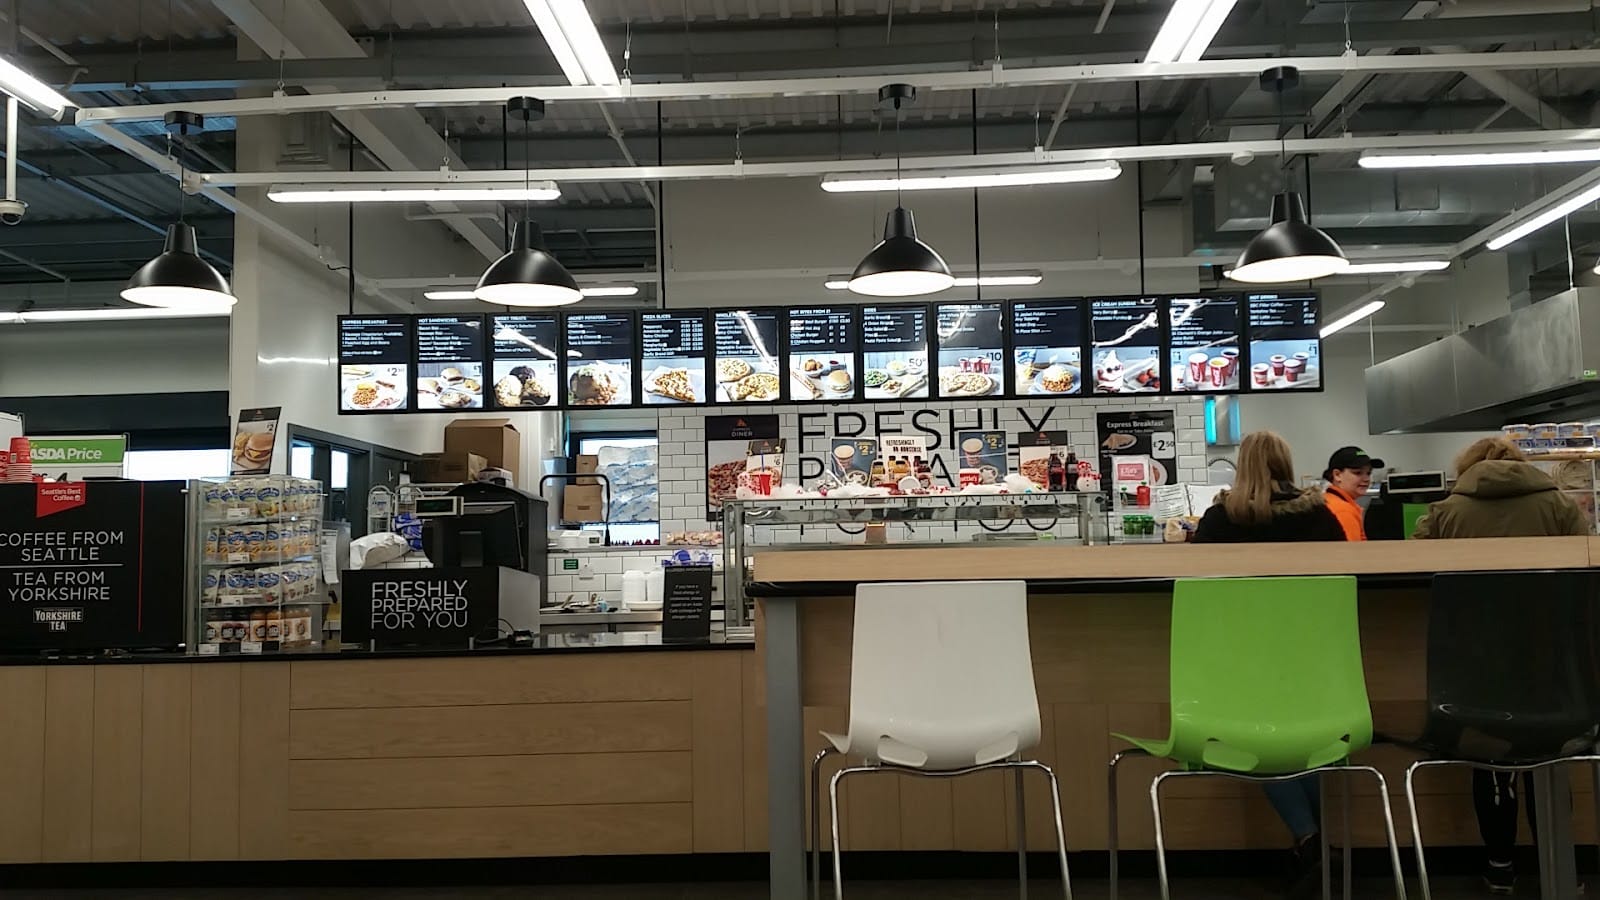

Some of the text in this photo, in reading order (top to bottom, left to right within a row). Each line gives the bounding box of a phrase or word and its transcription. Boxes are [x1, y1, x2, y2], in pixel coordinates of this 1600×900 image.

[1107, 420, 1164, 429] Express Breakfast
[30, 448, 102, 460] ASDA Price
[0, 531, 124, 546] COFFEE FROM
[21, 547, 100, 562] SEATTLE
[12, 571, 104, 586] TEA FROM
[8, 587, 110, 601] YORKSHIRE
[372, 580, 468, 598] FRESHLY
[372, 596, 468, 612] PREPARED
[35, 610, 82, 622] YORKSHIRE
[372, 610, 468, 629] FOR YOU
[50, 621, 67, 632] TEA
